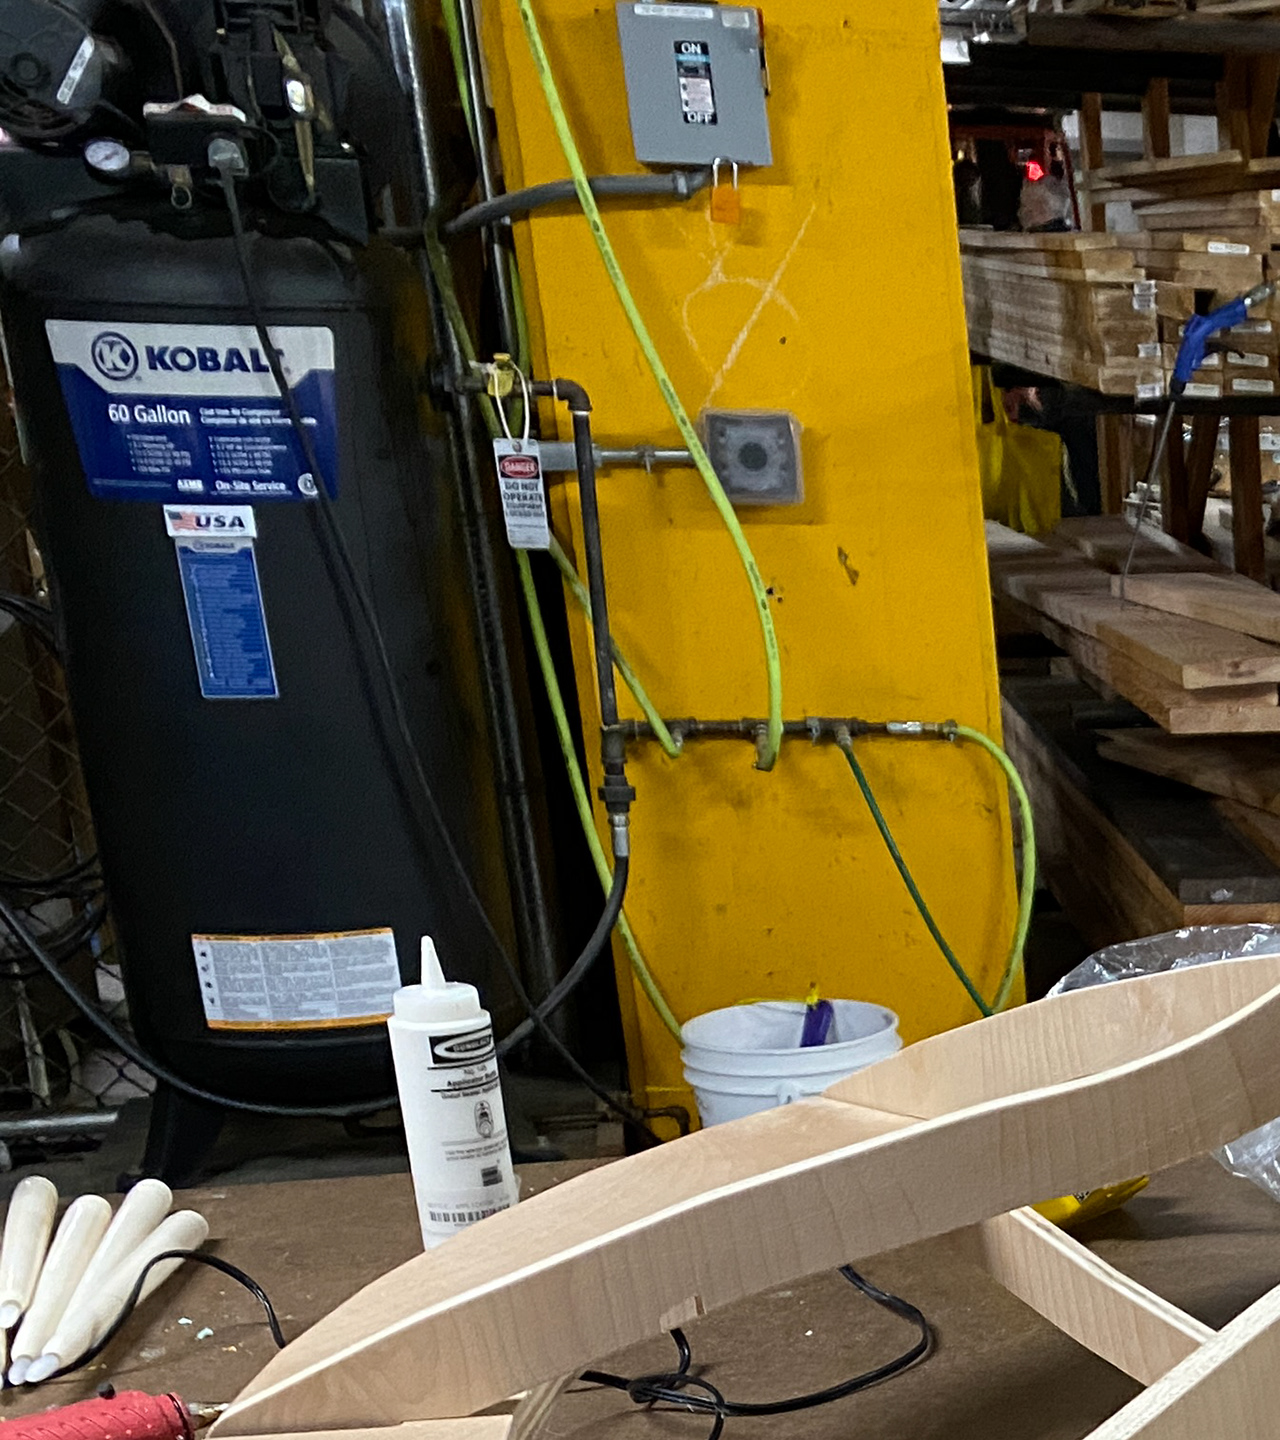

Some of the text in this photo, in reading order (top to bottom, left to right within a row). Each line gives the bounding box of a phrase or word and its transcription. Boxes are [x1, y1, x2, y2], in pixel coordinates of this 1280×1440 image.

[681, 42, 702, 55] ON
[687, 112, 713, 124] OFF
[108, 405, 129, 425] 60
[133, 404, 191, 426] Gallon
[503, 461, 536, 472] DANGER
[251, 480, 287, 491] Service
[505, 482, 539, 491] DO NOT
[503, 492, 543, 502] OPERATE
[195, 515, 246, 529] USA
